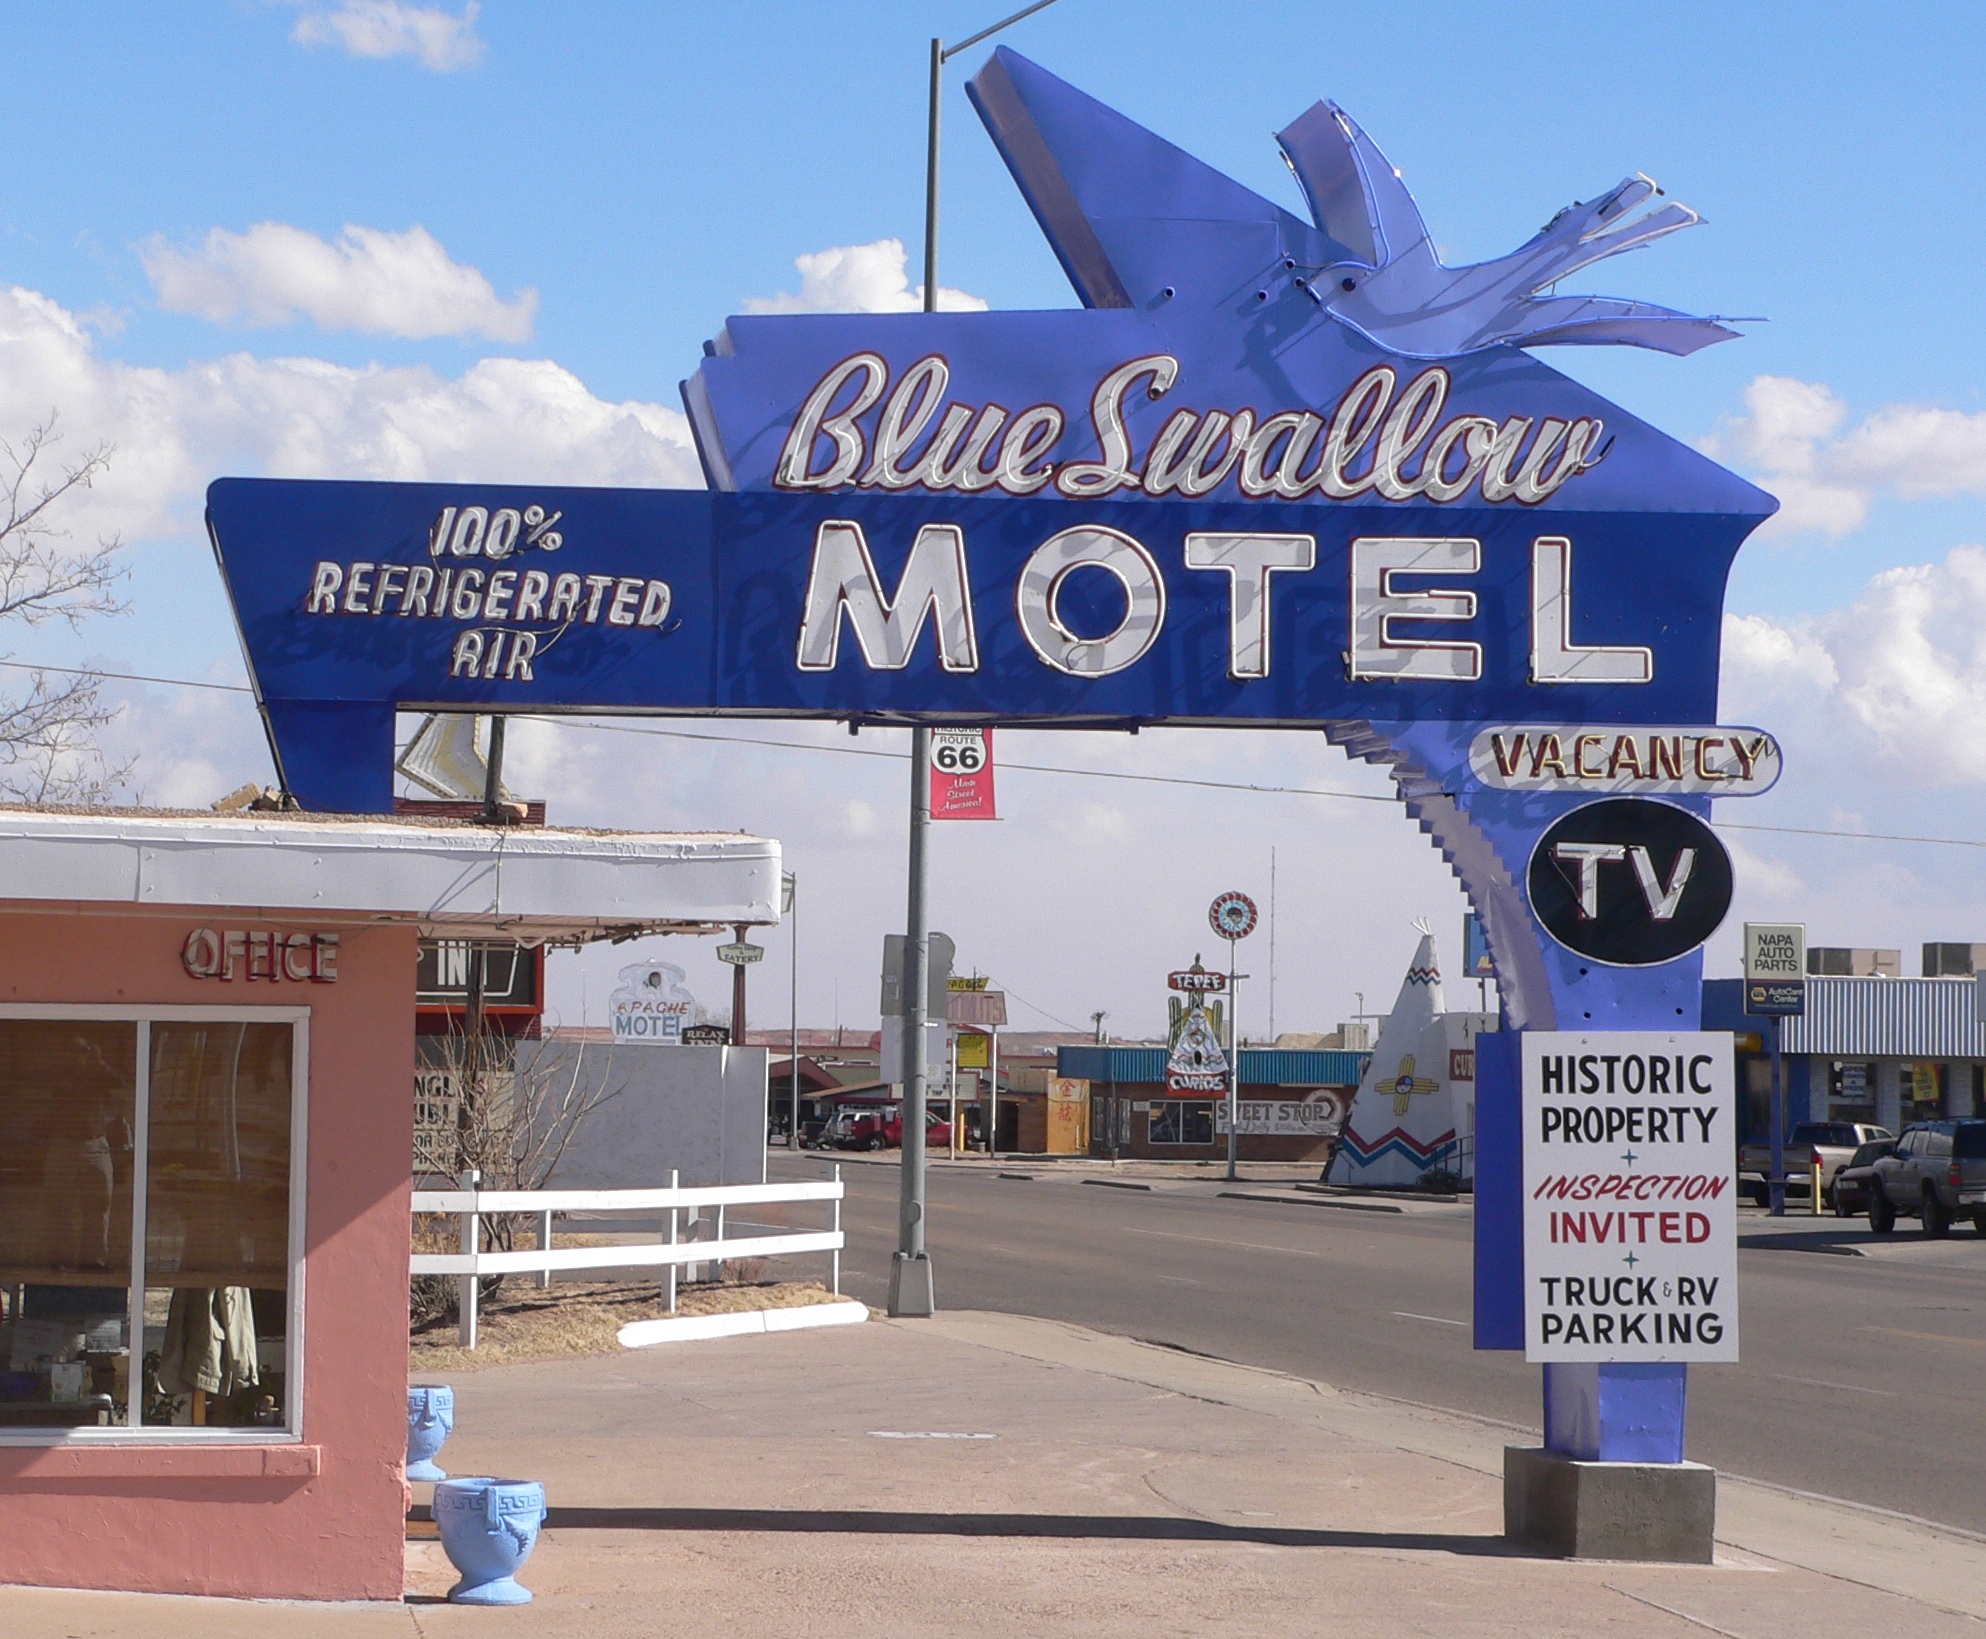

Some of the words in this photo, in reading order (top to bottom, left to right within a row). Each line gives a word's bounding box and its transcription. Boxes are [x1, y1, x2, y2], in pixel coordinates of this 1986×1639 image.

[775, 352, 1064, 494] Blue
[1055, 356, 1606, 504] Swallow
[431, 504, 563, 558] 100%
[307, 561, 673, 627] REFRIGERATED
[796, 519, 1656, 687] MOTEL
[450, 630, 537, 682] AIR
[940, 736, 977, 745] ROUTE
[937, 745, 980, 769] 66
[1491, 732, 1768, 781] VACANCY
[1552, 841, 1698, 922] TV
[1757, 934, 1794, 946] NAPA
[1757, 947, 1795, 959] AUTO
[182, 928, 340, 984] OFFICE
[1754, 959, 1798, 971] PARTS
[1173, 974, 1221, 989] TEPEE
[617, 1001, 691, 1014] APACHE
[615, 1015, 682, 1036] MOTEL
[687, 1030, 726, 1039] RELAX
[1169, 1075, 1225, 1091] CURIOS
[1541, 1054, 1714, 1094] HISTORIC
[1278, 1103, 1324, 1121] STOP
[1541, 1106, 1719, 1143] PROPERTY
[1534, 1174, 1729, 1200] INSPECTION
[1551, 1212, 1711, 1243] INVITED
[1540, 1276, 1659, 1307] TRUCK
[1662, 1281, 1673, 1297] &
[1678, 1276, 1719, 1307] RV
[1541, 1312, 1724, 1345] PARKING
